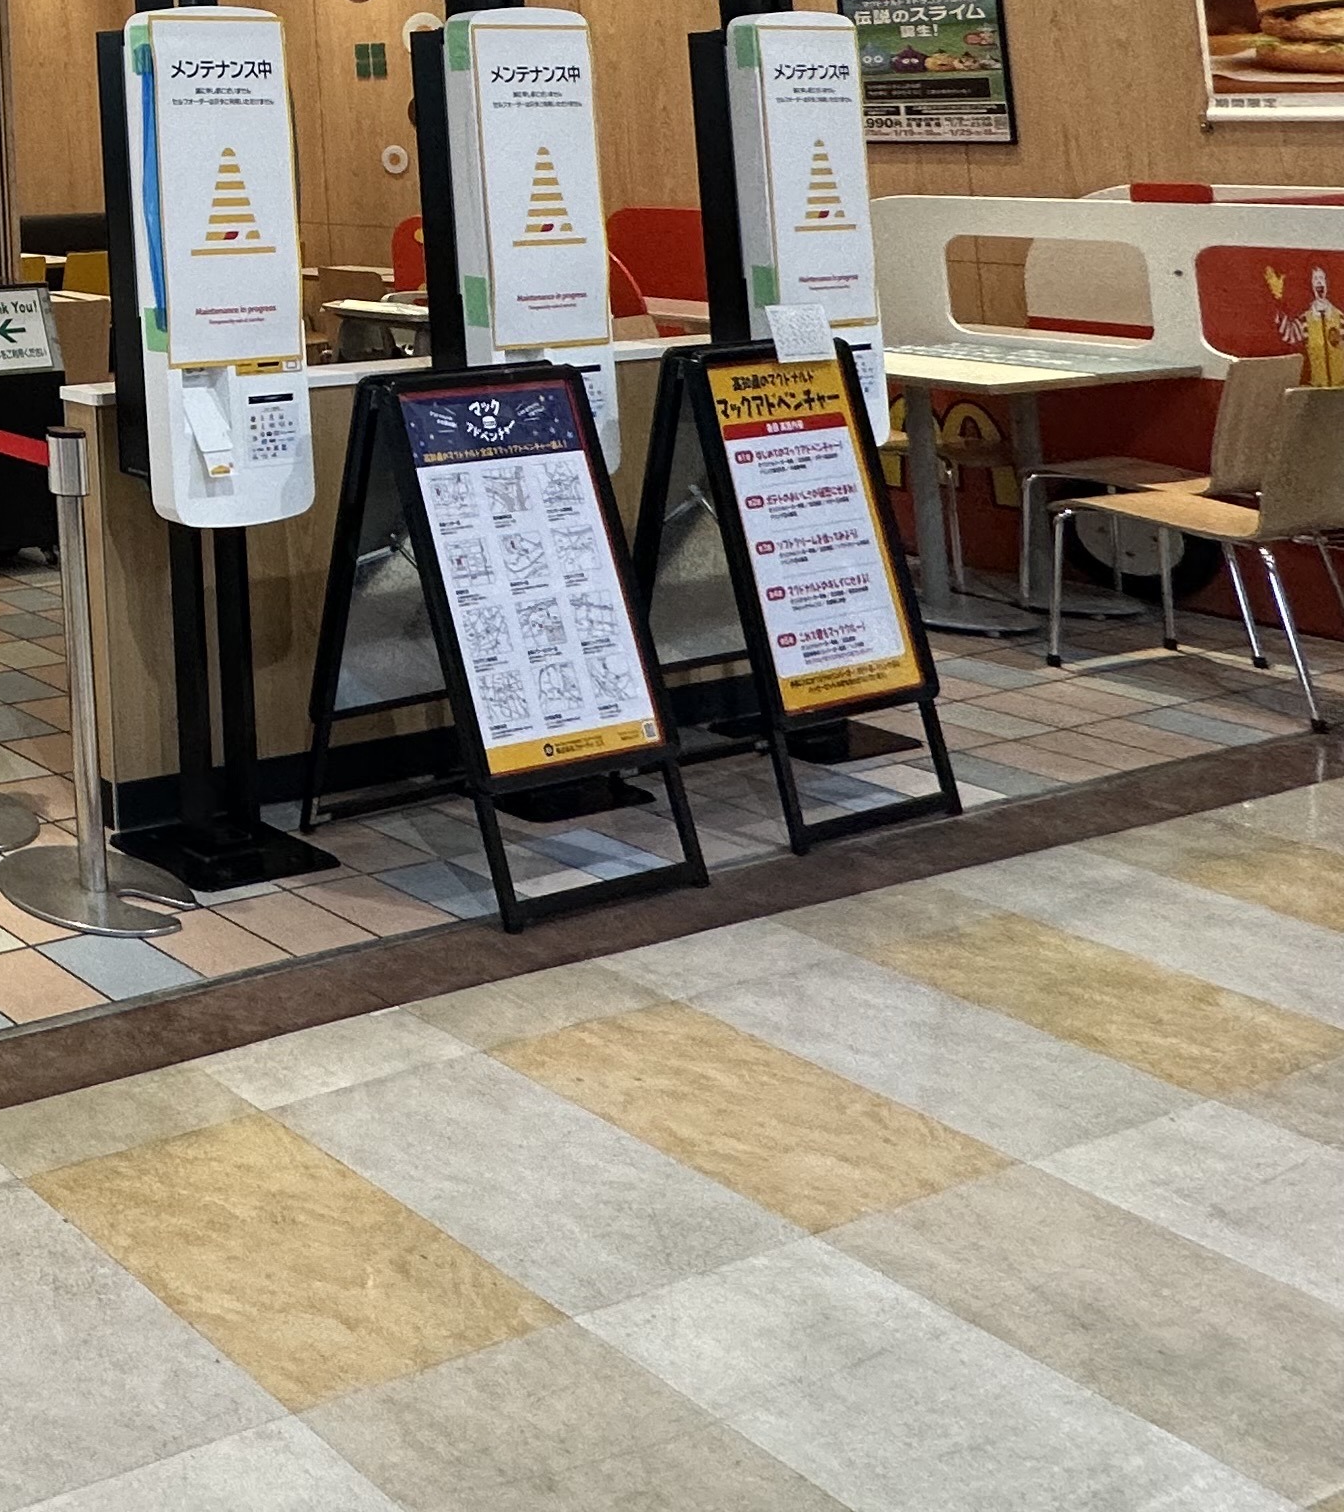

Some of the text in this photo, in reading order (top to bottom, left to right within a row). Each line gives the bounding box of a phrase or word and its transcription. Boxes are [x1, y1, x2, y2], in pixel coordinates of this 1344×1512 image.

[854, 3, 986, 25] 伝説のスライム
[170, 59, 273, 80] メンテナンス中
[490, 65, 581, 83] メンテナンス中
[773, 63, 851, 81] メンテナンス中
[10, 299, 38, 314] You!
[468, 398, 501, 417] マック
[715, 388, 840, 419] マックアドベンチャー
